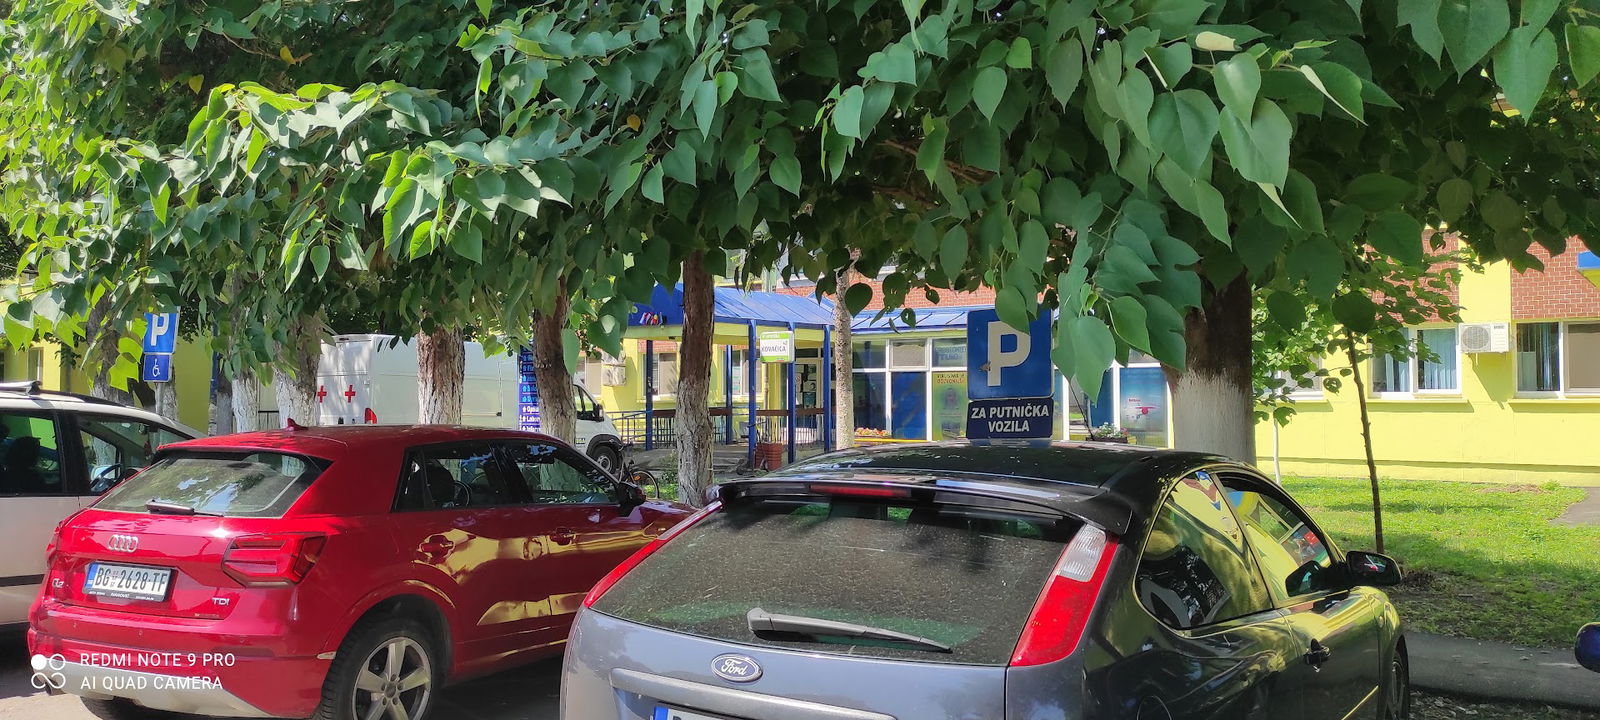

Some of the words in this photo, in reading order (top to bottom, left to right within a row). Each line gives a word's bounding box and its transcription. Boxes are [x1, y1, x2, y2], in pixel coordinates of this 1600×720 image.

[150, 313, 169, 346] P
[987, 320, 1032, 387] P
[971, 407, 987, 419] ZA
[989, 403, 1050, 418] PUTNIČKA
[988, 420, 1030, 433] VOZILA
[95, 567, 111, 587] BG
[211, 597, 230, 606] TDI
[720, 659, 748, 676] Ford
